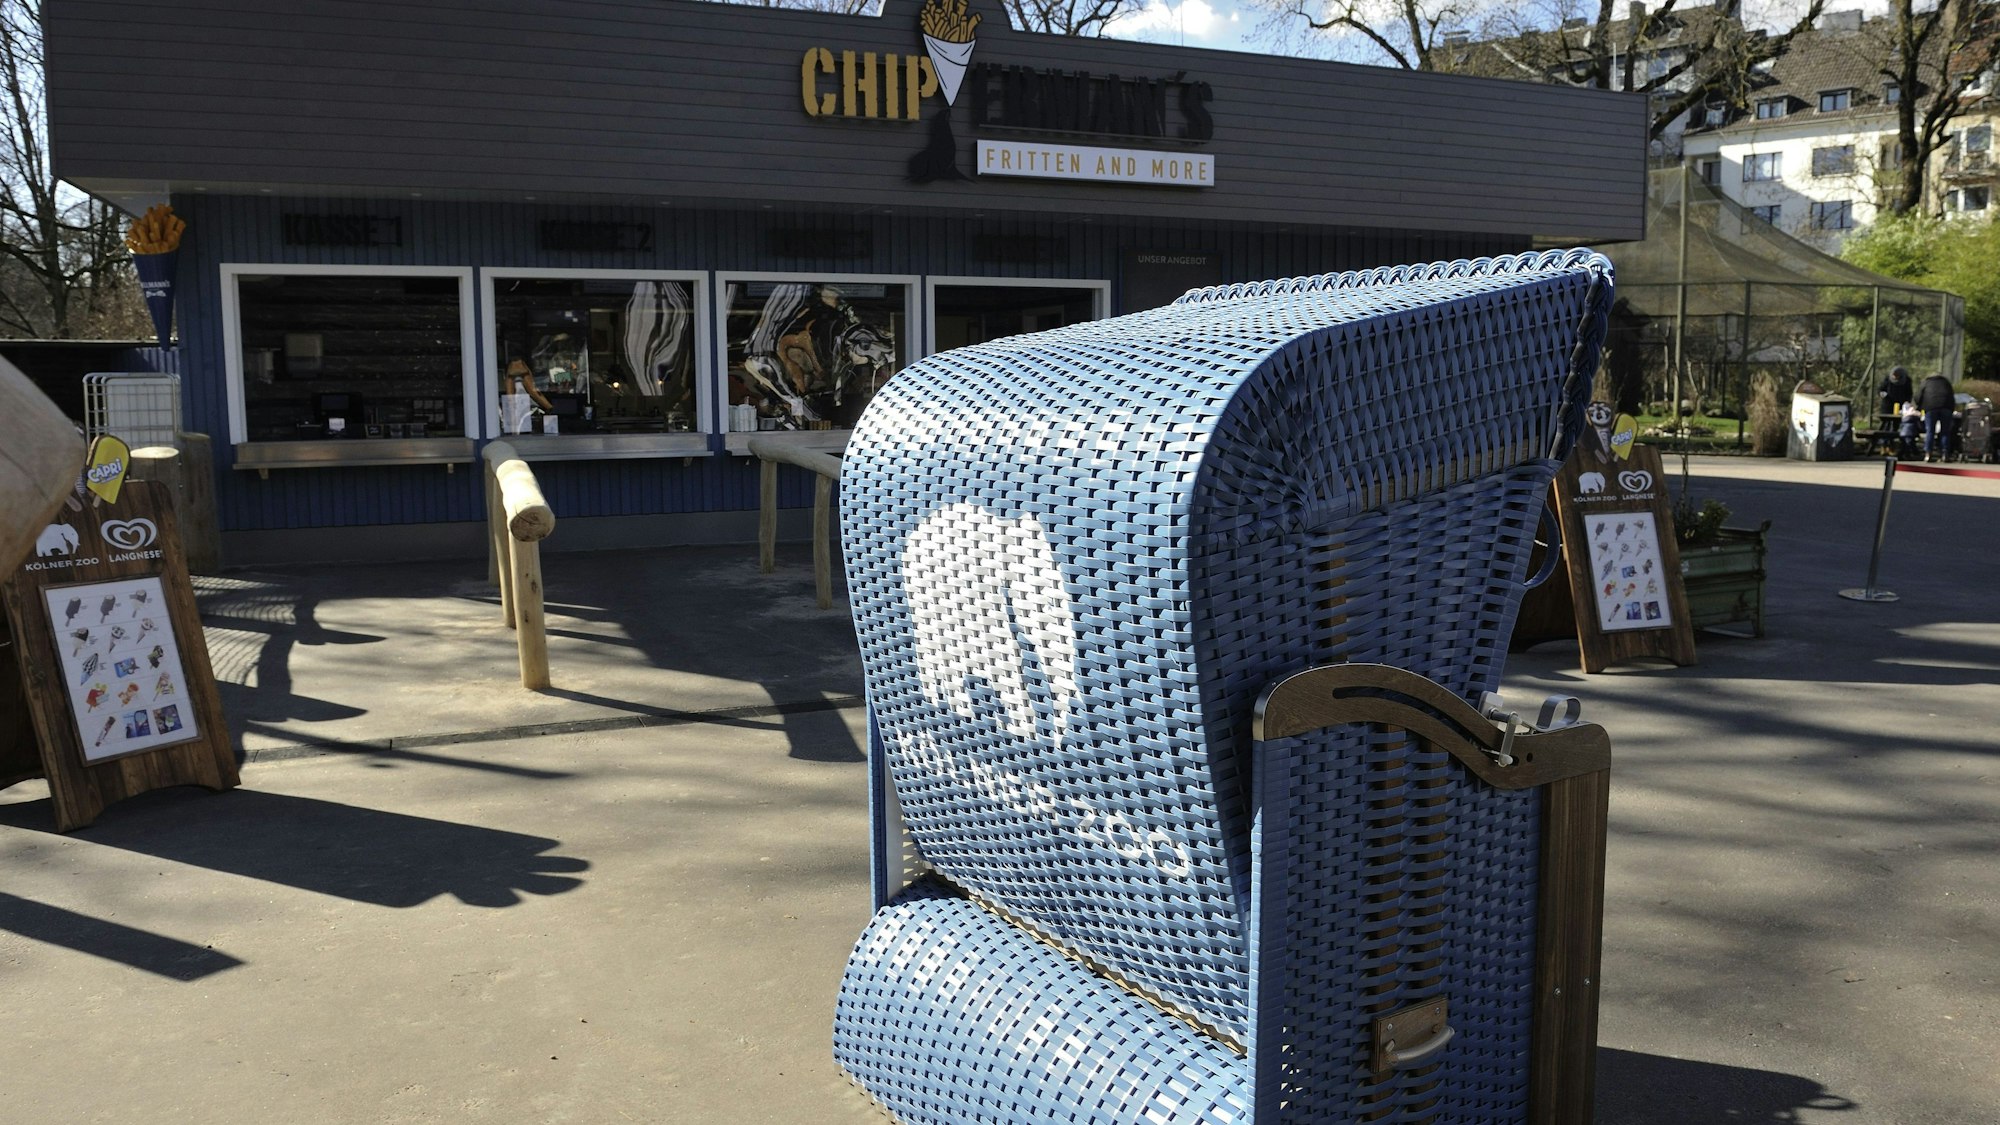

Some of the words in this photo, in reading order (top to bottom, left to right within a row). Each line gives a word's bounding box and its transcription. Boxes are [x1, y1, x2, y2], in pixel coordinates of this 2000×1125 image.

[986, 148, 1081, 173] FRITTEN
[1096, 155, 1137, 177] AND
[1152, 159, 1207, 181] MORE
[1137, 255, 1166, 264] UNSER
[1167, 256, 1207, 265] ANGEBOT
[109, 550, 161, 563] LANGNESE
[25, 559, 73, 571] KÖLNER
[76, 557, 99, 566] ZOO
[1070, 797, 1191, 878] ZOO
